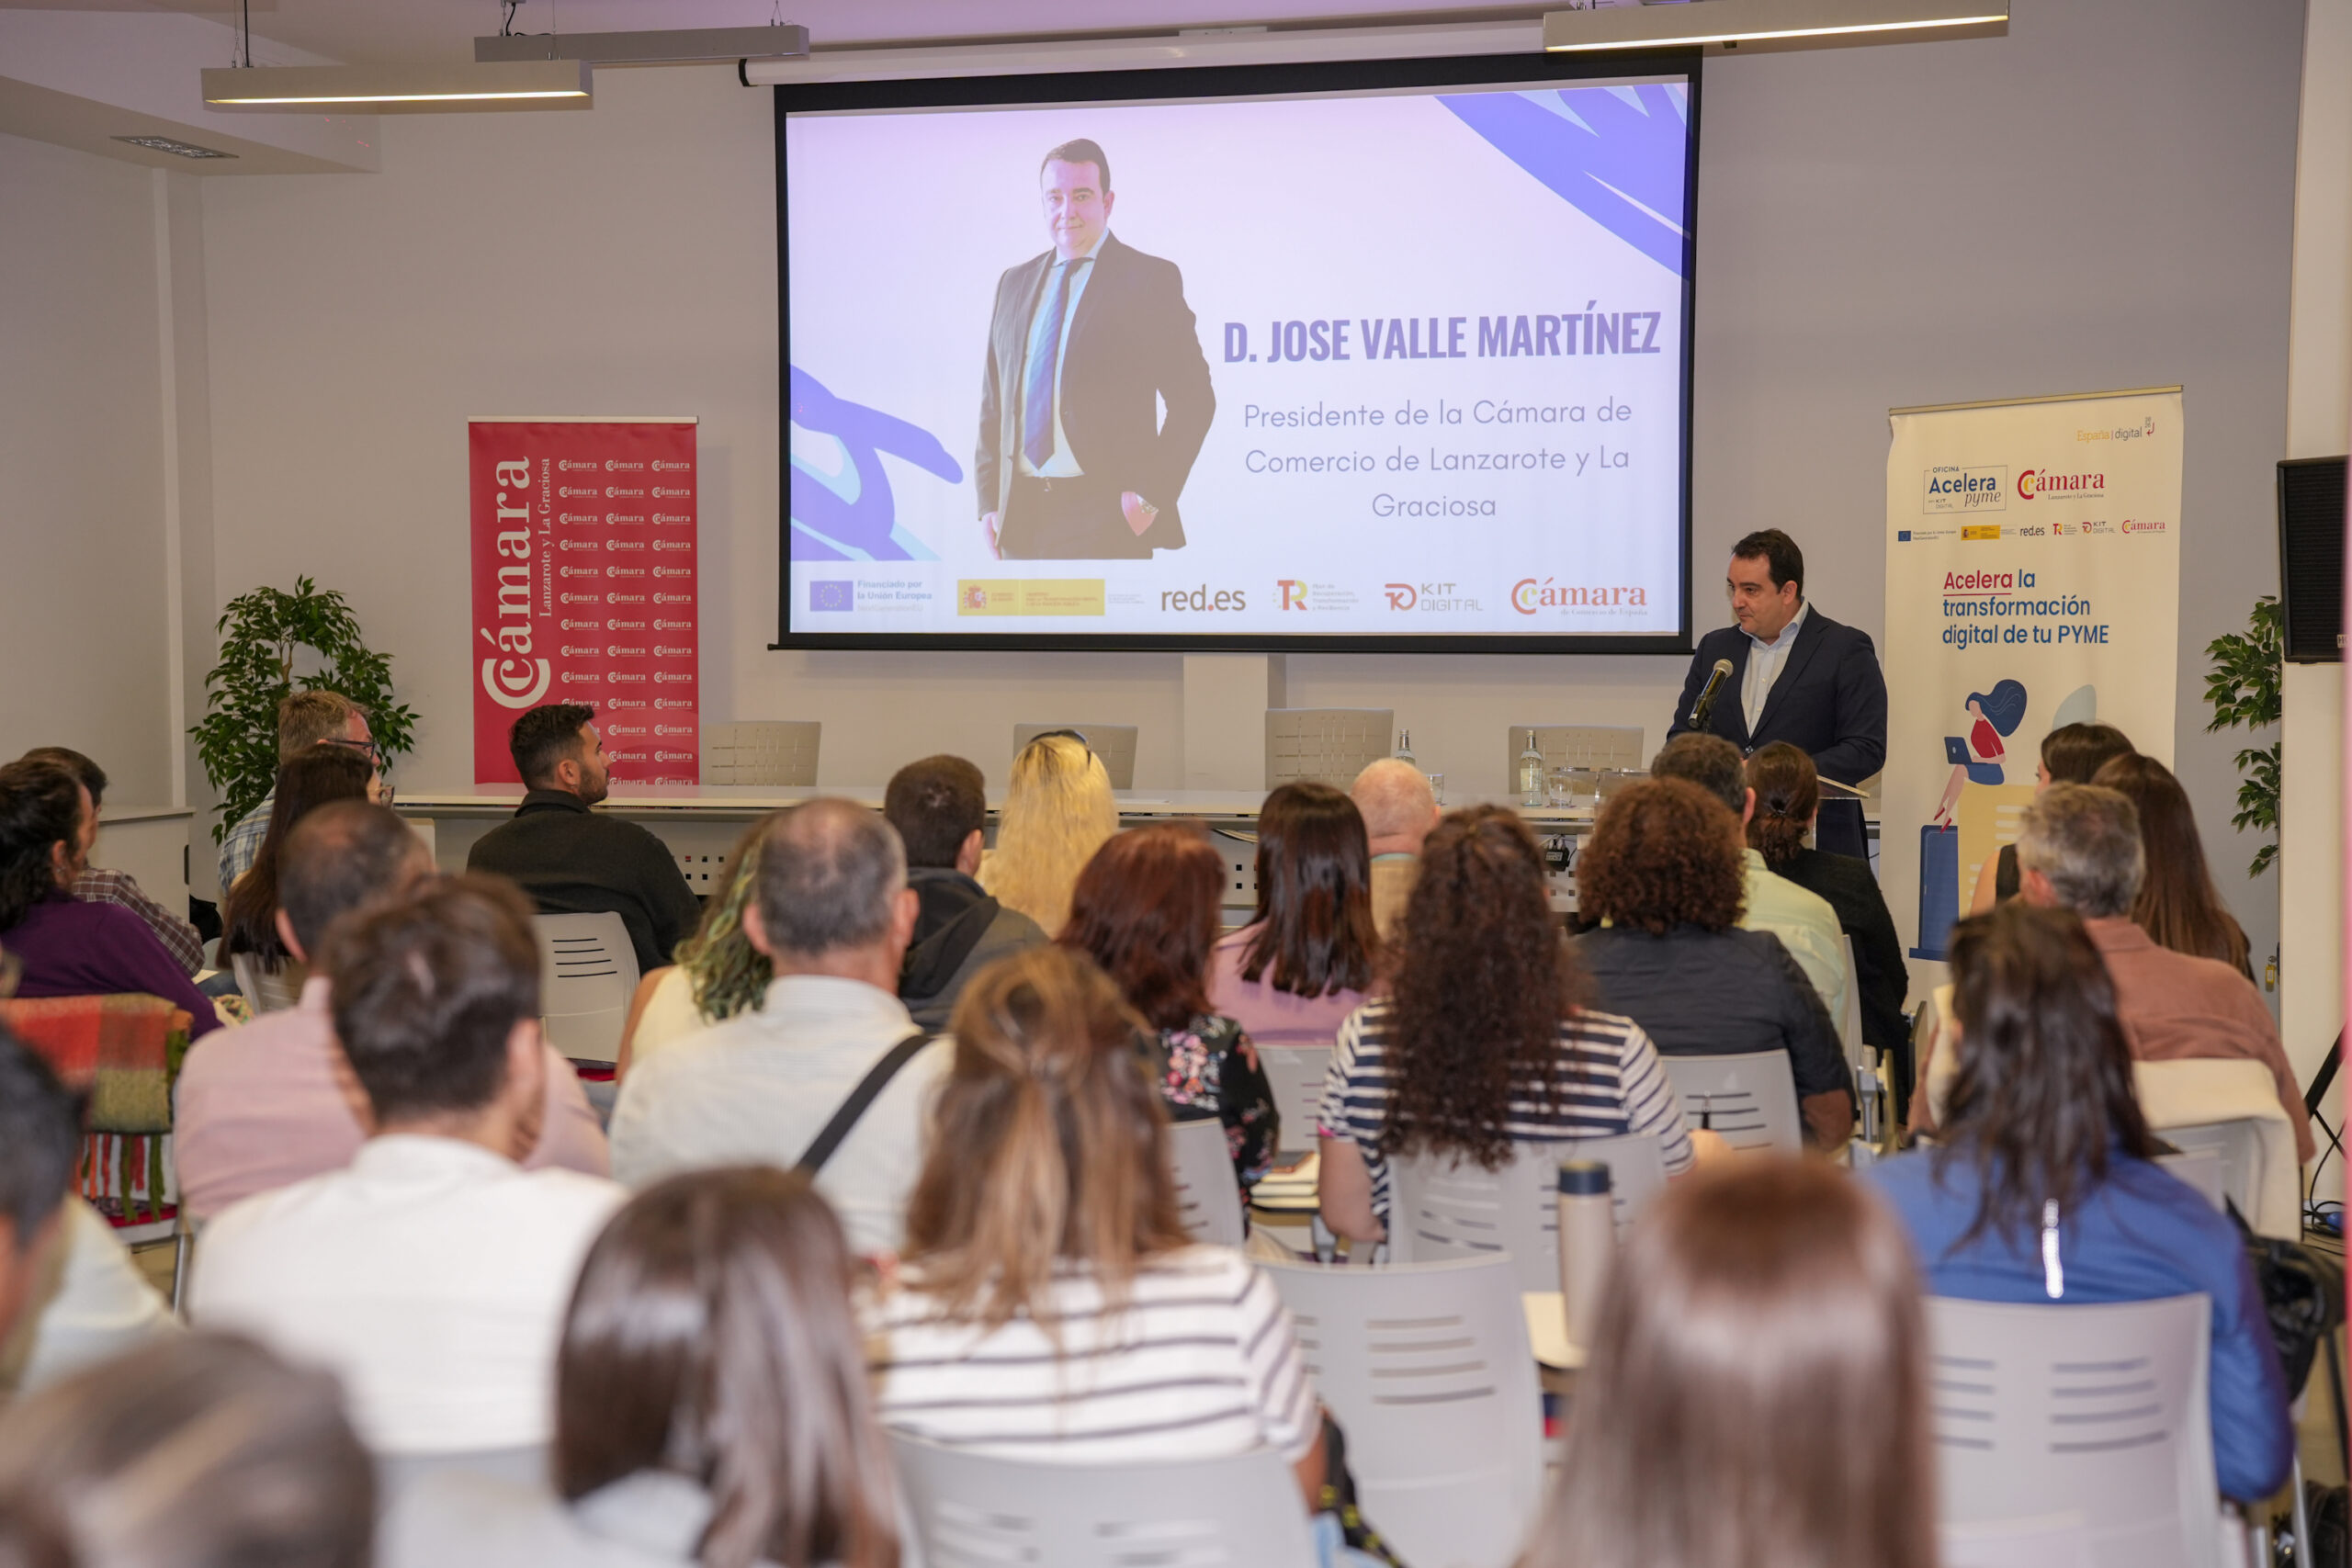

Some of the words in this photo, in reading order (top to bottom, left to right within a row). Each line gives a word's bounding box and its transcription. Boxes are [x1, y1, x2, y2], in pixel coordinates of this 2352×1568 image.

[1224, 321, 1258, 363] D.
[1267, 319, 1351, 363] JOSE
[1360, 316, 1467, 360] VALLE
[1477, 299, 1662, 357] MARTÍNEZ
[1244, 400, 1385, 428] Presidente
[1395, 399, 1430, 426] de
[1440, 398, 1463, 425] la
[1473, 399, 1586, 424] Cámara
[1597, 395, 1632, 423] de
[2115, 425, 2143, 442] digital
[559, 459, 597, 471] Cámara
[605, 459, 643, 471] Cámara
[651, 459, 690, 471] Cámara
[1245, 448, 1376, 473] Comercio
[1385, 445, 1419, 471] de
[1430, 446, 1566, 471] Lanzarote
[1576, 451, 1589, 477] y
[1600, 444, 1630, 469] La
[1932, 466, 1960, 474] OFICINA
[537, 458, 550, 515] Graciosa
[1928, 472, 1996, 494] Acelera
[2017, 468, 2105, 500] Cámara
[559, 486, 597, 498] Cámara
[605, 486, 644, 498] Cámara
[652, 486, 690, 498] Cámara
[1372, 492, 1497, 518] Graciosa
[1964, 491, 2001, 508] pyme
[560, 513, 598, 524] Cámara
[606, 513, 644, 524] Cámara
[652, 513, 691, 524] Cámara
[538, 519, 551, 536] La
[2019, 525, 2045, 537] red.es
[2121, 518, 2165, 534] Cámara
[542, 538, 555, 548] y
[560, 539, 598, 550] Cámara
[606, 539, 644, 550] Cámara
[652, 539, 691, 550] Cámara
[560, 566, 598, 577] Cámara
[606, 566, 645, 577] Cámara
[653, 566, 691, 577] Cámara
[480, 457, 550, 709] Cámara
[538, 547, 551, 618] Lanzarote
[1943, 570, 2013, 590] Acelera
[2018, 569, 2036, 589] la
[1420, 582, 1457, 596] KIT
[560, 592, 599, 604] Cámara
[607, 592, 645, 604] Cámara
[653, 592, 691, 604] Cámara
[1161, 583, 1247, 612] red.es
[1511, 577, 1648, 615] Cámara
[1420, 598, 1485, 612] DIGITAL
[1942, 594, 2090, 616] transformación
[560, 619, 599, 630] Cámara
[607, 619, 645, 630] Cámara
[653, 619, 691, 630] Cámara
[1942, 624, 1997, 649] digital
[2003, 624, 2028, 643] de
[2032, 626, 2052, 644] tu
[2058, 625, 2109, 644] PYME
[561, 645, 599, 657] Cámara
[607, 645, 645, 657] Cámara
[654, 645, 692, 657] Cámara
[561, 671, 599, 683] Cámara
[608, 671, 646, 683] Cámara
[654, 671, 692, 683] Cámara
[608, 698, 646, 709] Cámara
[654, 698, 692, 709] Cámara
[608, 725, 646, 736] Cámara
[655, 725, 693, 736] Cámara
[655, 751, 693, 762] Cámara
